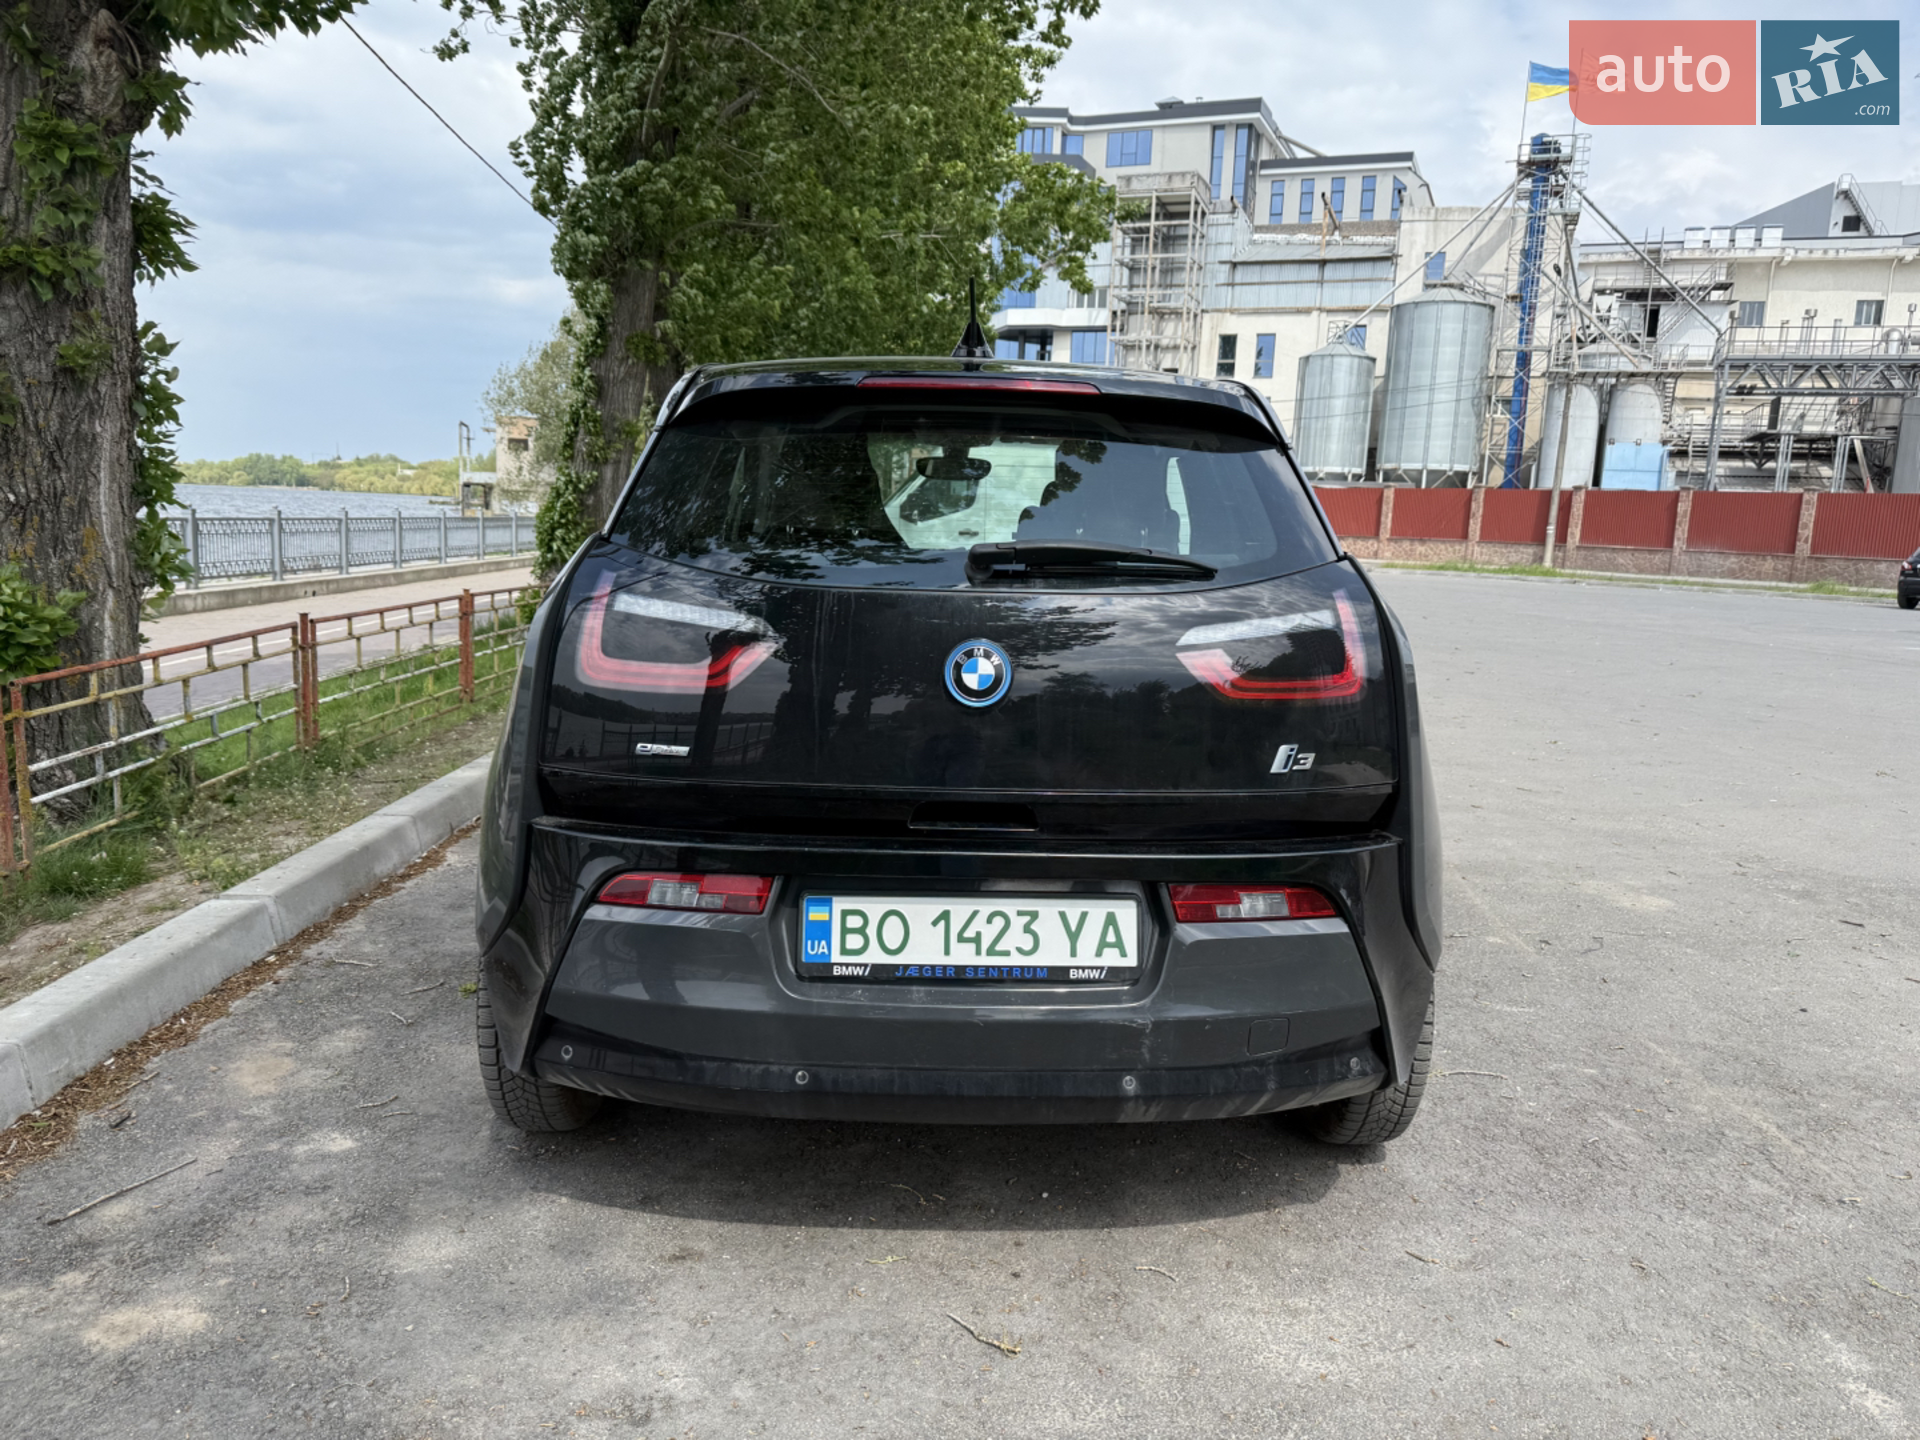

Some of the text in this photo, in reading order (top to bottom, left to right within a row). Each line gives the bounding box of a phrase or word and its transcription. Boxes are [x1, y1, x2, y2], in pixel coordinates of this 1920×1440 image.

[1269, 744, 1316, 774] i3
[839, 908, 1128, 958] BO 1423 YA
[807, 940, 829, 956] UA
[895, 966, 1049, 978] JÆGER SENTRUM
